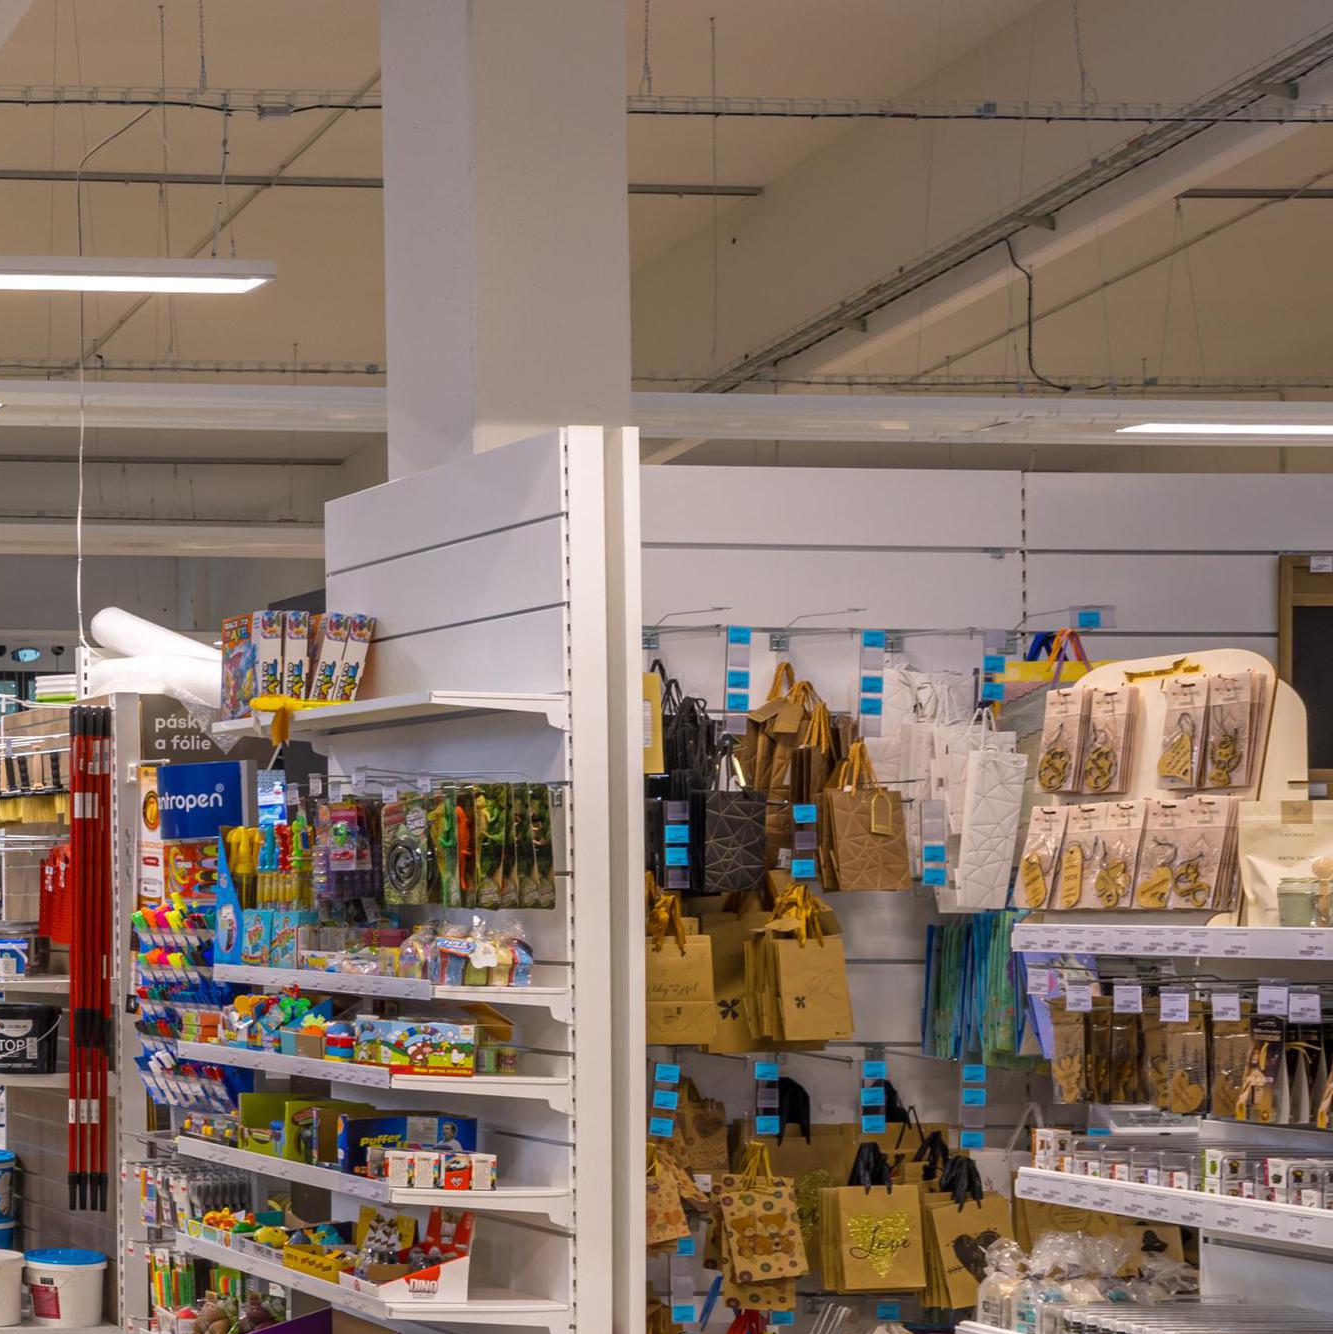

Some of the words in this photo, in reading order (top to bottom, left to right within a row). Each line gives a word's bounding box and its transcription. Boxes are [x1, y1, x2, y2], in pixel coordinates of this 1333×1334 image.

[155, 740, 166, 750] a
[171, 735, 211, 750] fólie
[850, 1225, 911, 1260] Love
